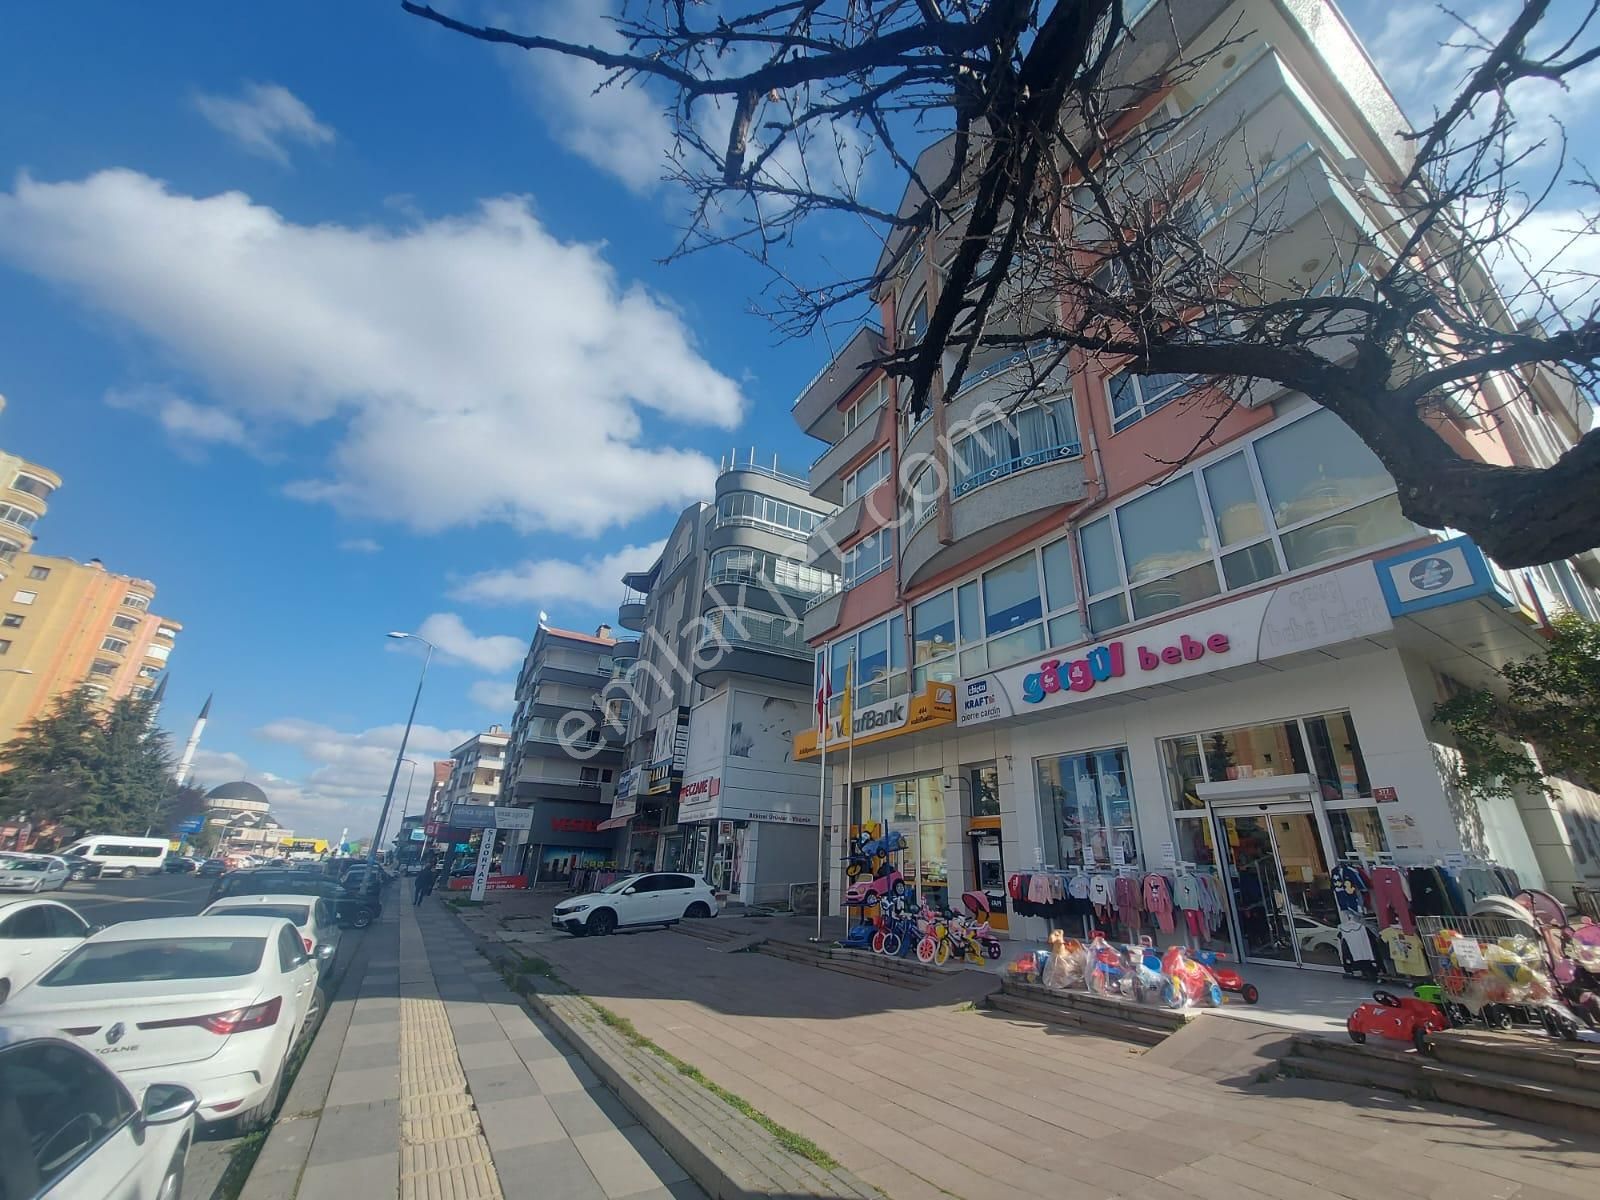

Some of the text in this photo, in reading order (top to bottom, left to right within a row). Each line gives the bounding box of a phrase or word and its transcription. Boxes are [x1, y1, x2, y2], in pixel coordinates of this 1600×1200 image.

[1137, 633, 1231, 671] bebe
[964, 696, 989, 710] KRAFT
[961, 712, 980, 724] pierre
[980, 706, 1001, 718] cardin
